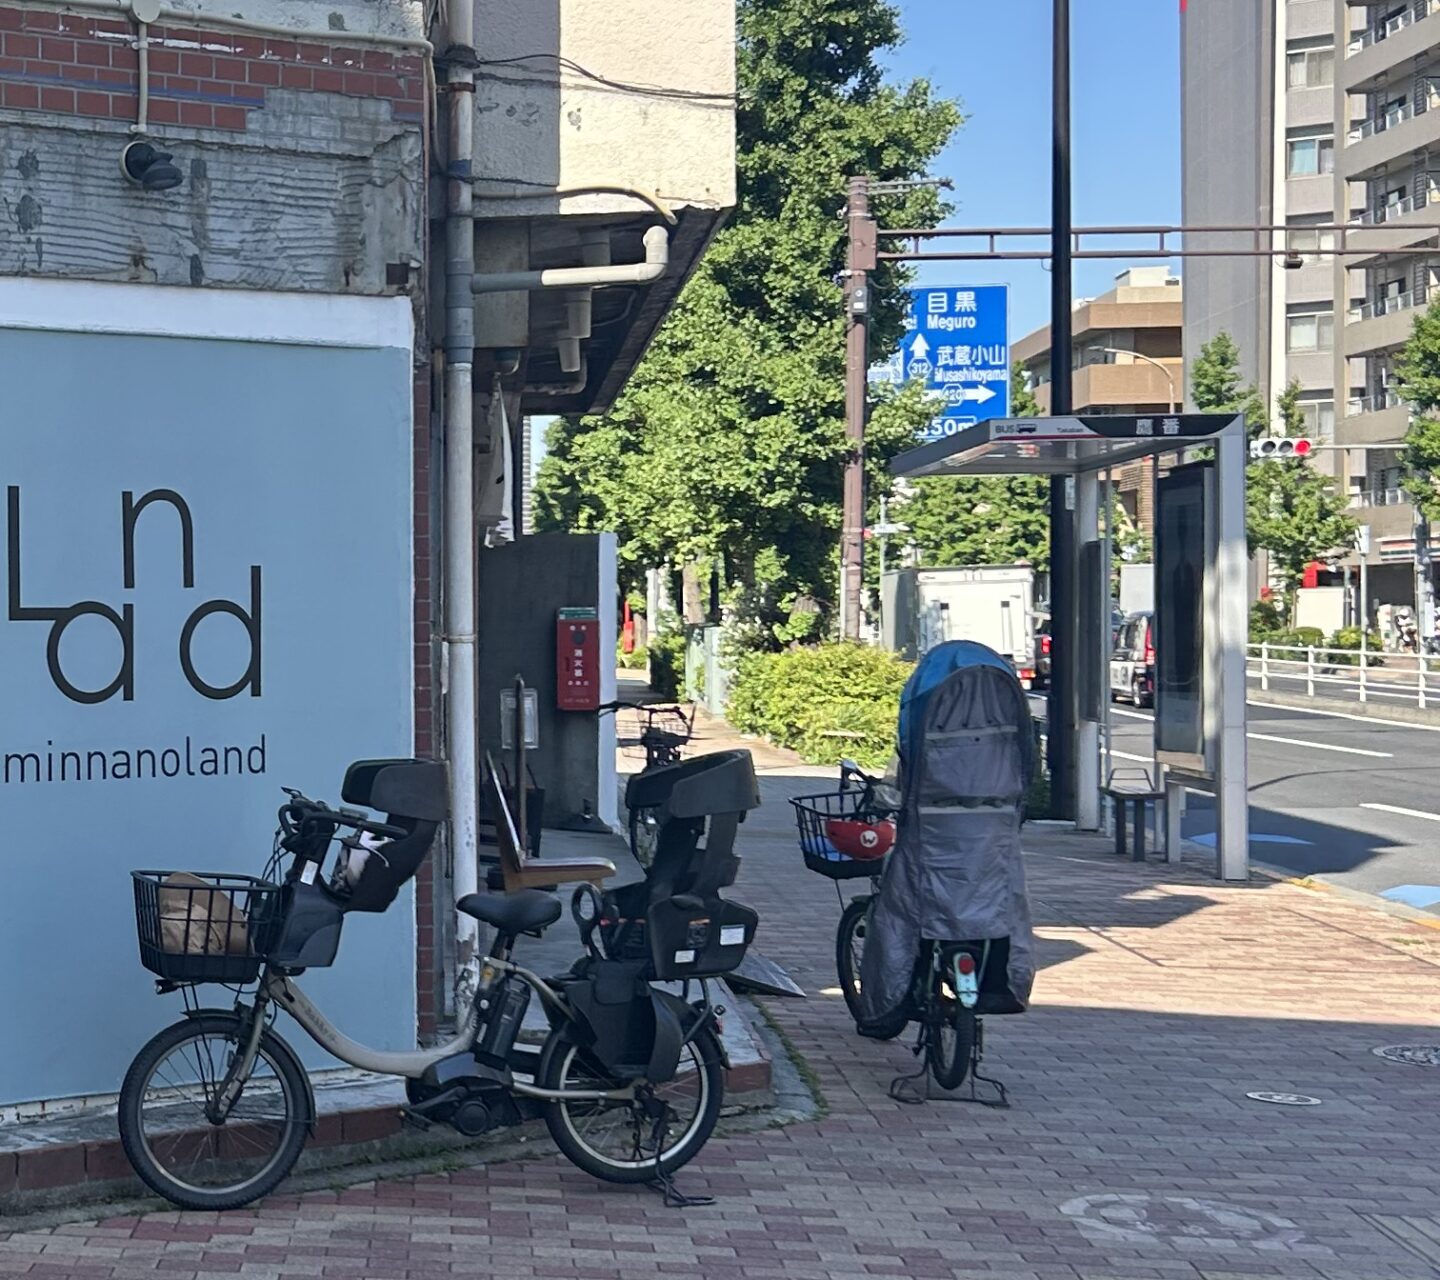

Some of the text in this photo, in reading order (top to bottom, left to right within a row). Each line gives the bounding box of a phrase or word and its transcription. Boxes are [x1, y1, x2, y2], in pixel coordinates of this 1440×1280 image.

[927, 291, 978, 313] 目黒
[927, 314, 976, 331] Meguro
[936, 344, 1006, 366] 武蔵小山
[911, 362, 929, 374] 312
[934, 367, 1007, 384] Musashikoyama
[995, 424, 1015, 433] BUS
[4, 733, 266, 783] minnanoland
